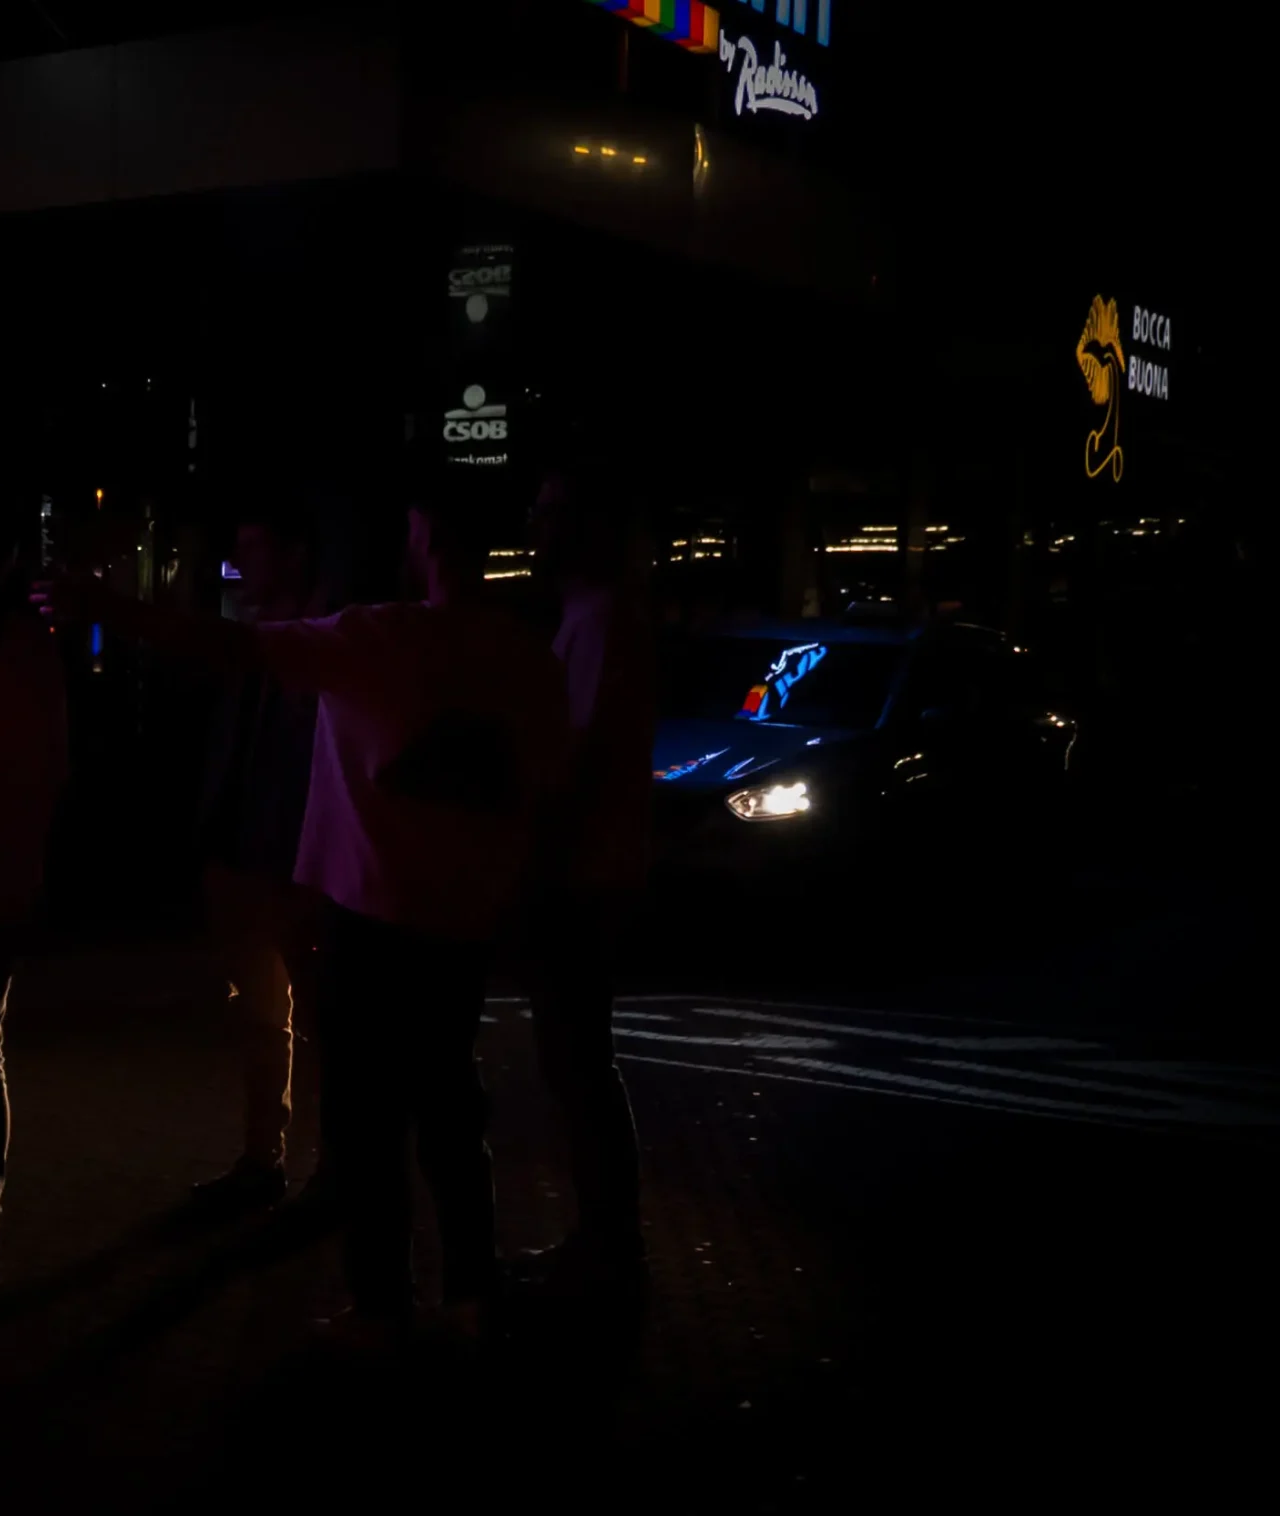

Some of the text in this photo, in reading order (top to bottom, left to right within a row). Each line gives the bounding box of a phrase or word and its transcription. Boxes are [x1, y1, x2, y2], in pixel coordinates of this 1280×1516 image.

[719, 28, 818, 119] by Radisson
[1132, 305, 1171, 351] BOCCA
[1128, 355, 1169, 401] BUONA
[446, 452, 509, 466] ankomat
